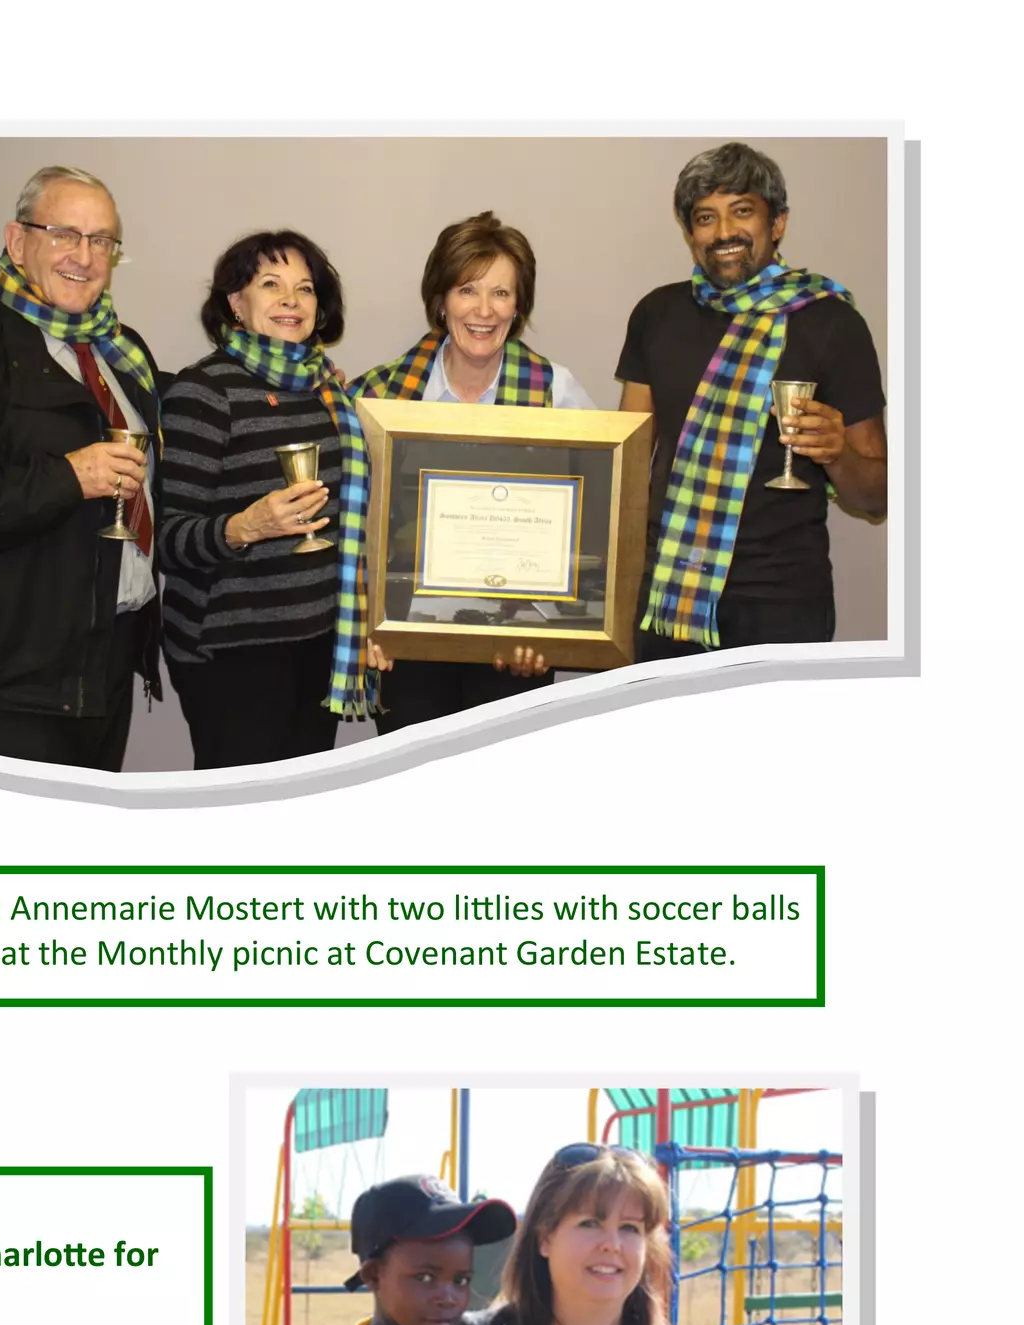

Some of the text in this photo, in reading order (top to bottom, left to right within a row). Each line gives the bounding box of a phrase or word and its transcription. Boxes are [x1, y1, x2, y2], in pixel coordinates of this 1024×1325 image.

[10, 895, 175, 921] Annemarie
[186, 895, 305, 921] Mostert
[313, 893, 378, 921] with
[387, 897, 445, 921] two
[455, 893, 544, 921] littlies
[553, 893, 618, 921] with
[628, 901, 723, 921] soccer
[732, 893, 800, 921] balls
[1, 938, 735, 972] at the Monthly picnic at Covenant Garden Estate.
[113, 1239, 160, 1268] for
